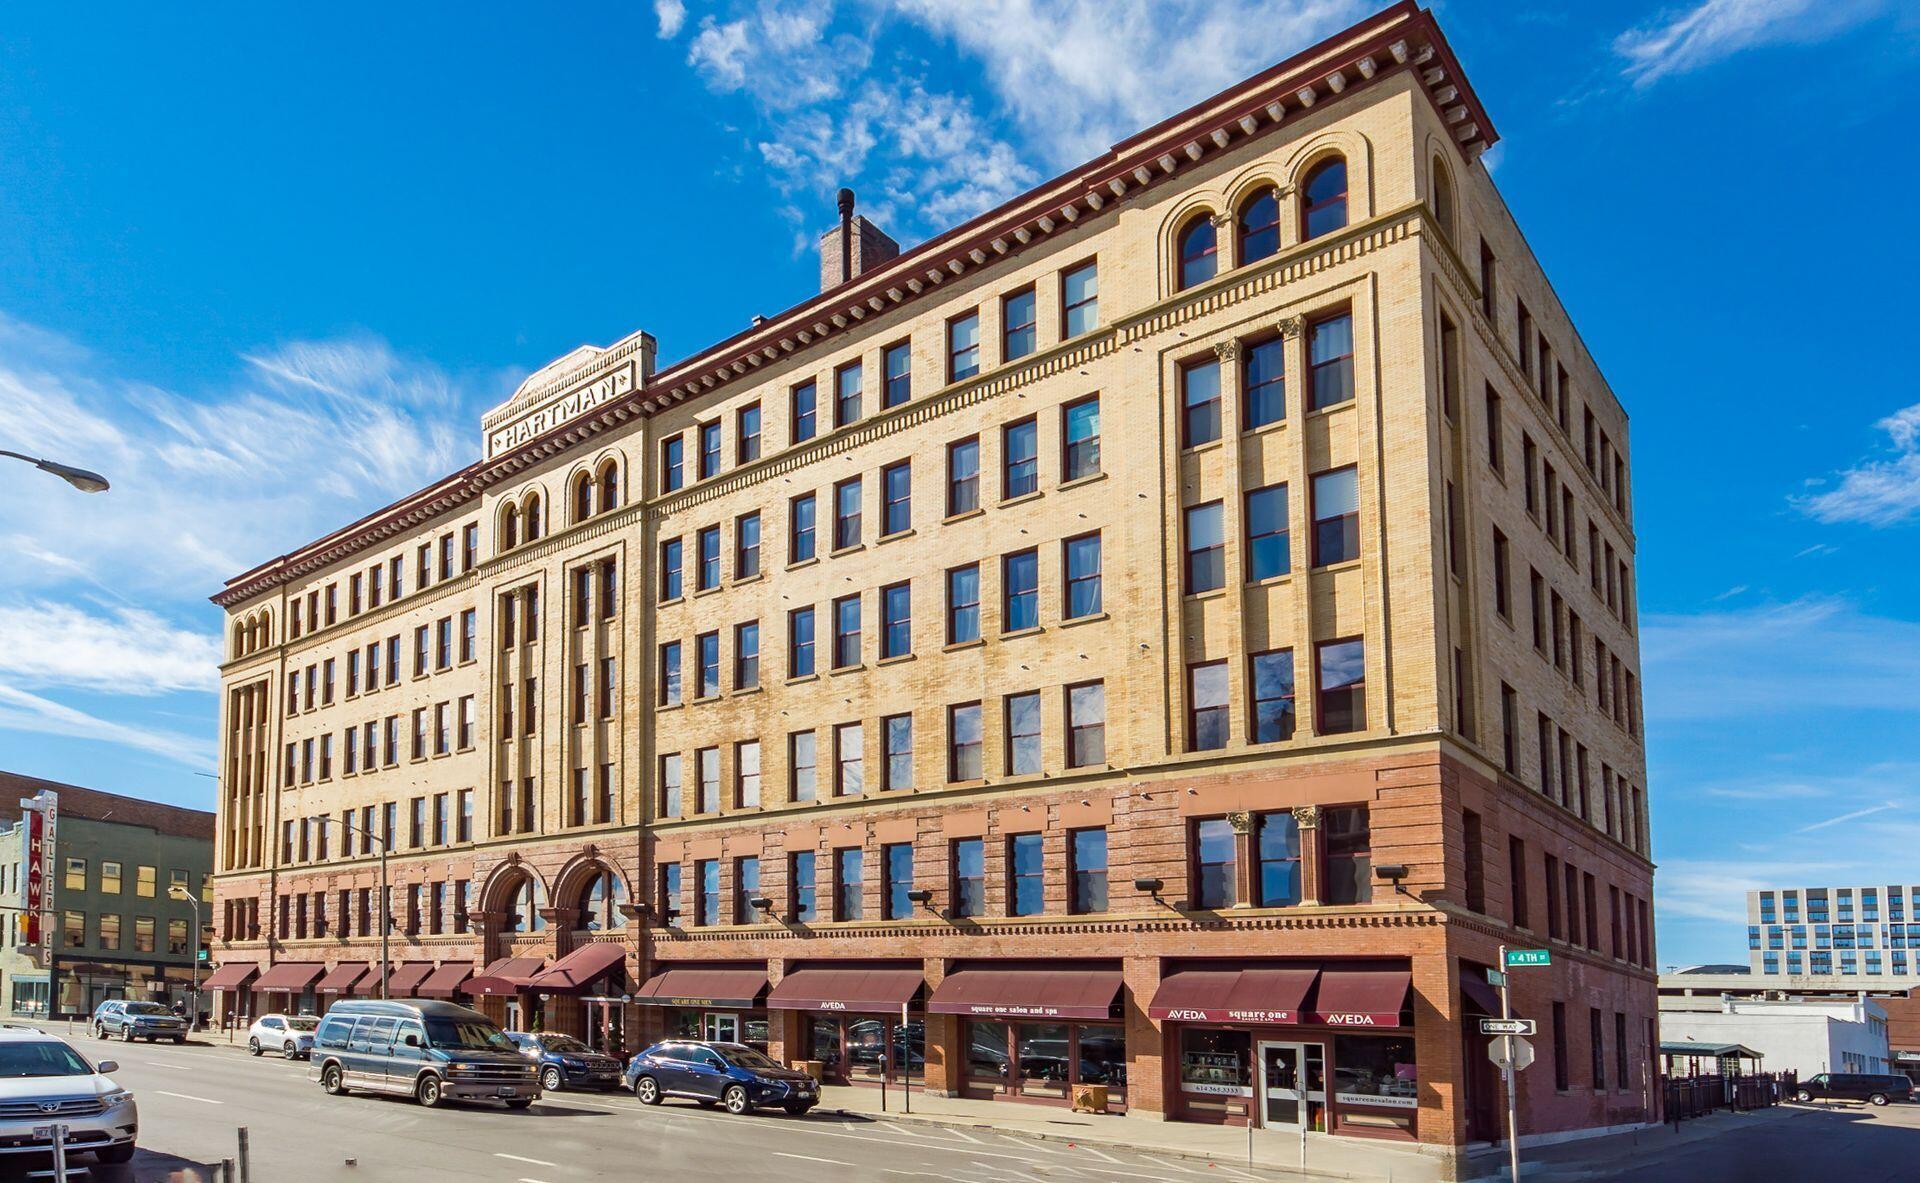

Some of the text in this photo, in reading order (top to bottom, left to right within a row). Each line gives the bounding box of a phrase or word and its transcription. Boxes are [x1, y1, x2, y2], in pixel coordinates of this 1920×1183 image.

[505, 376, 616, 447] HARTMAN
[30, 838, 42, 917] HAWK
[46, 808, 56, 963] GALLERES
[1518, 953, 1537, 962] 4TH
[820, 1001, 846, 1010] AVEDA
[971, 1005, 993, 1013] square
[1009, 1006, 1028, 1014] salon
[1168, 1010, 1207, 1020] AVEDA
[1228, 1011, 1287, 1019] square one
[1327, 1014, 1374, 1025] AVEDA
[1485, 1022, 1517, 1031] ONE WAY
